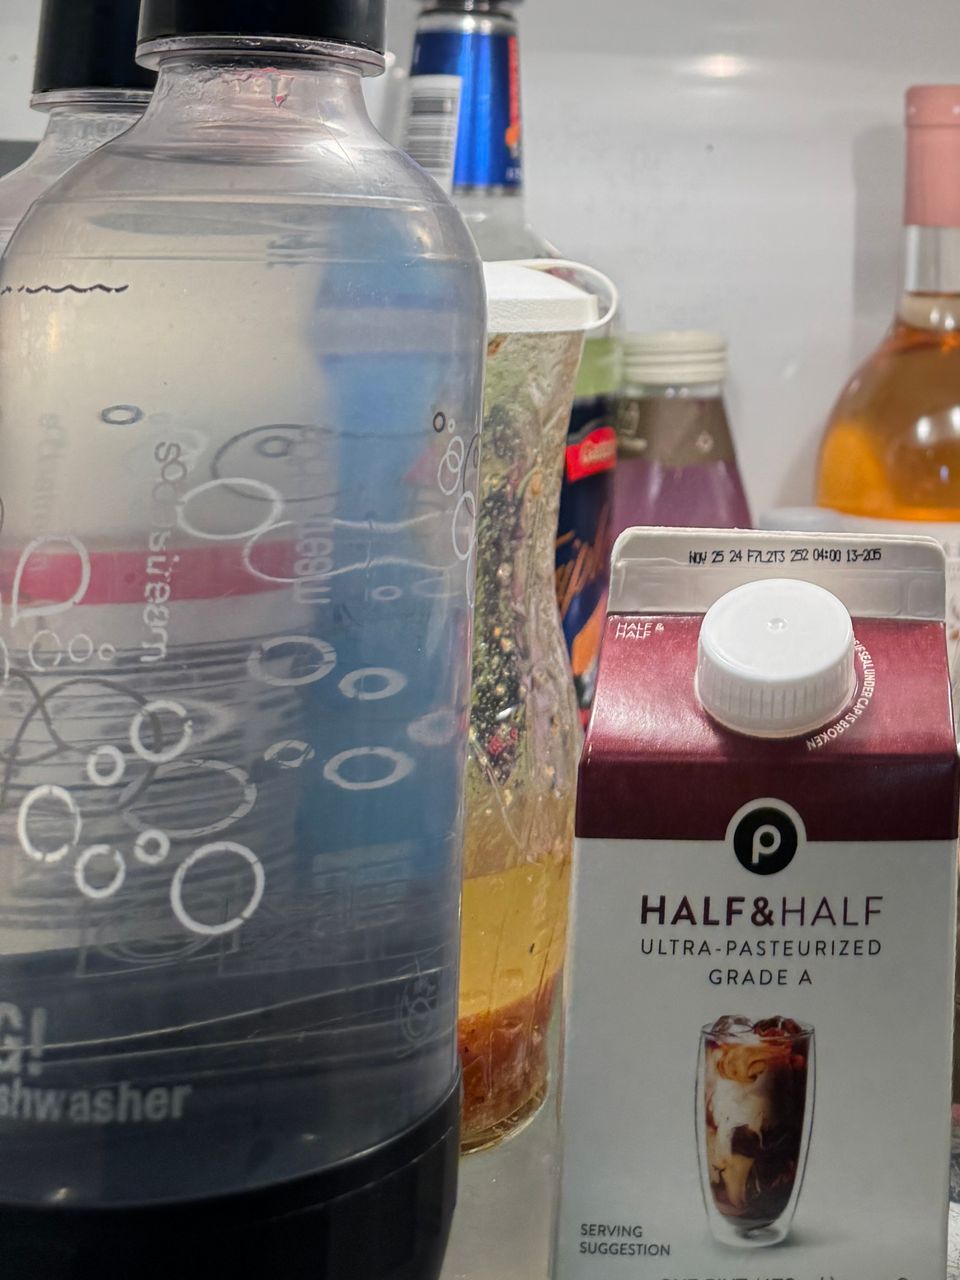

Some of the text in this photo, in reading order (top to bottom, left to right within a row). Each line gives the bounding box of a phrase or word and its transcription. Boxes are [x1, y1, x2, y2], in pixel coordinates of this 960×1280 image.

[688, 550, 708, 565] NOV
[711, 550, 724, 564] 25
[729, 550, 742, 563] 24
[790, 548, 809, 562] 252
[813, 548, 842, 562] 04:00
[846, 548, 882, 562] 13-205
[615, 630, 652, 639] HALF
[616, 622, 665, 631] HALF &
[857, 650, 875, 670] SEAL
[861, 668, 876, 698] UNDER
[853, 697, 869, 715] CAP
[844, 713, 858, 723] IS
[805, 719, 850, 751] BROKEN
[640, 894, 884, 927] HALF&HALF
[640, 938, 882, 957] ULTRA-PASTEURIZED
[708, 969, 813, 986] GRADE A
[580, 1223, 643, 1238] SERVING
[579, 1241, 671, 1256] SUGGESTION
